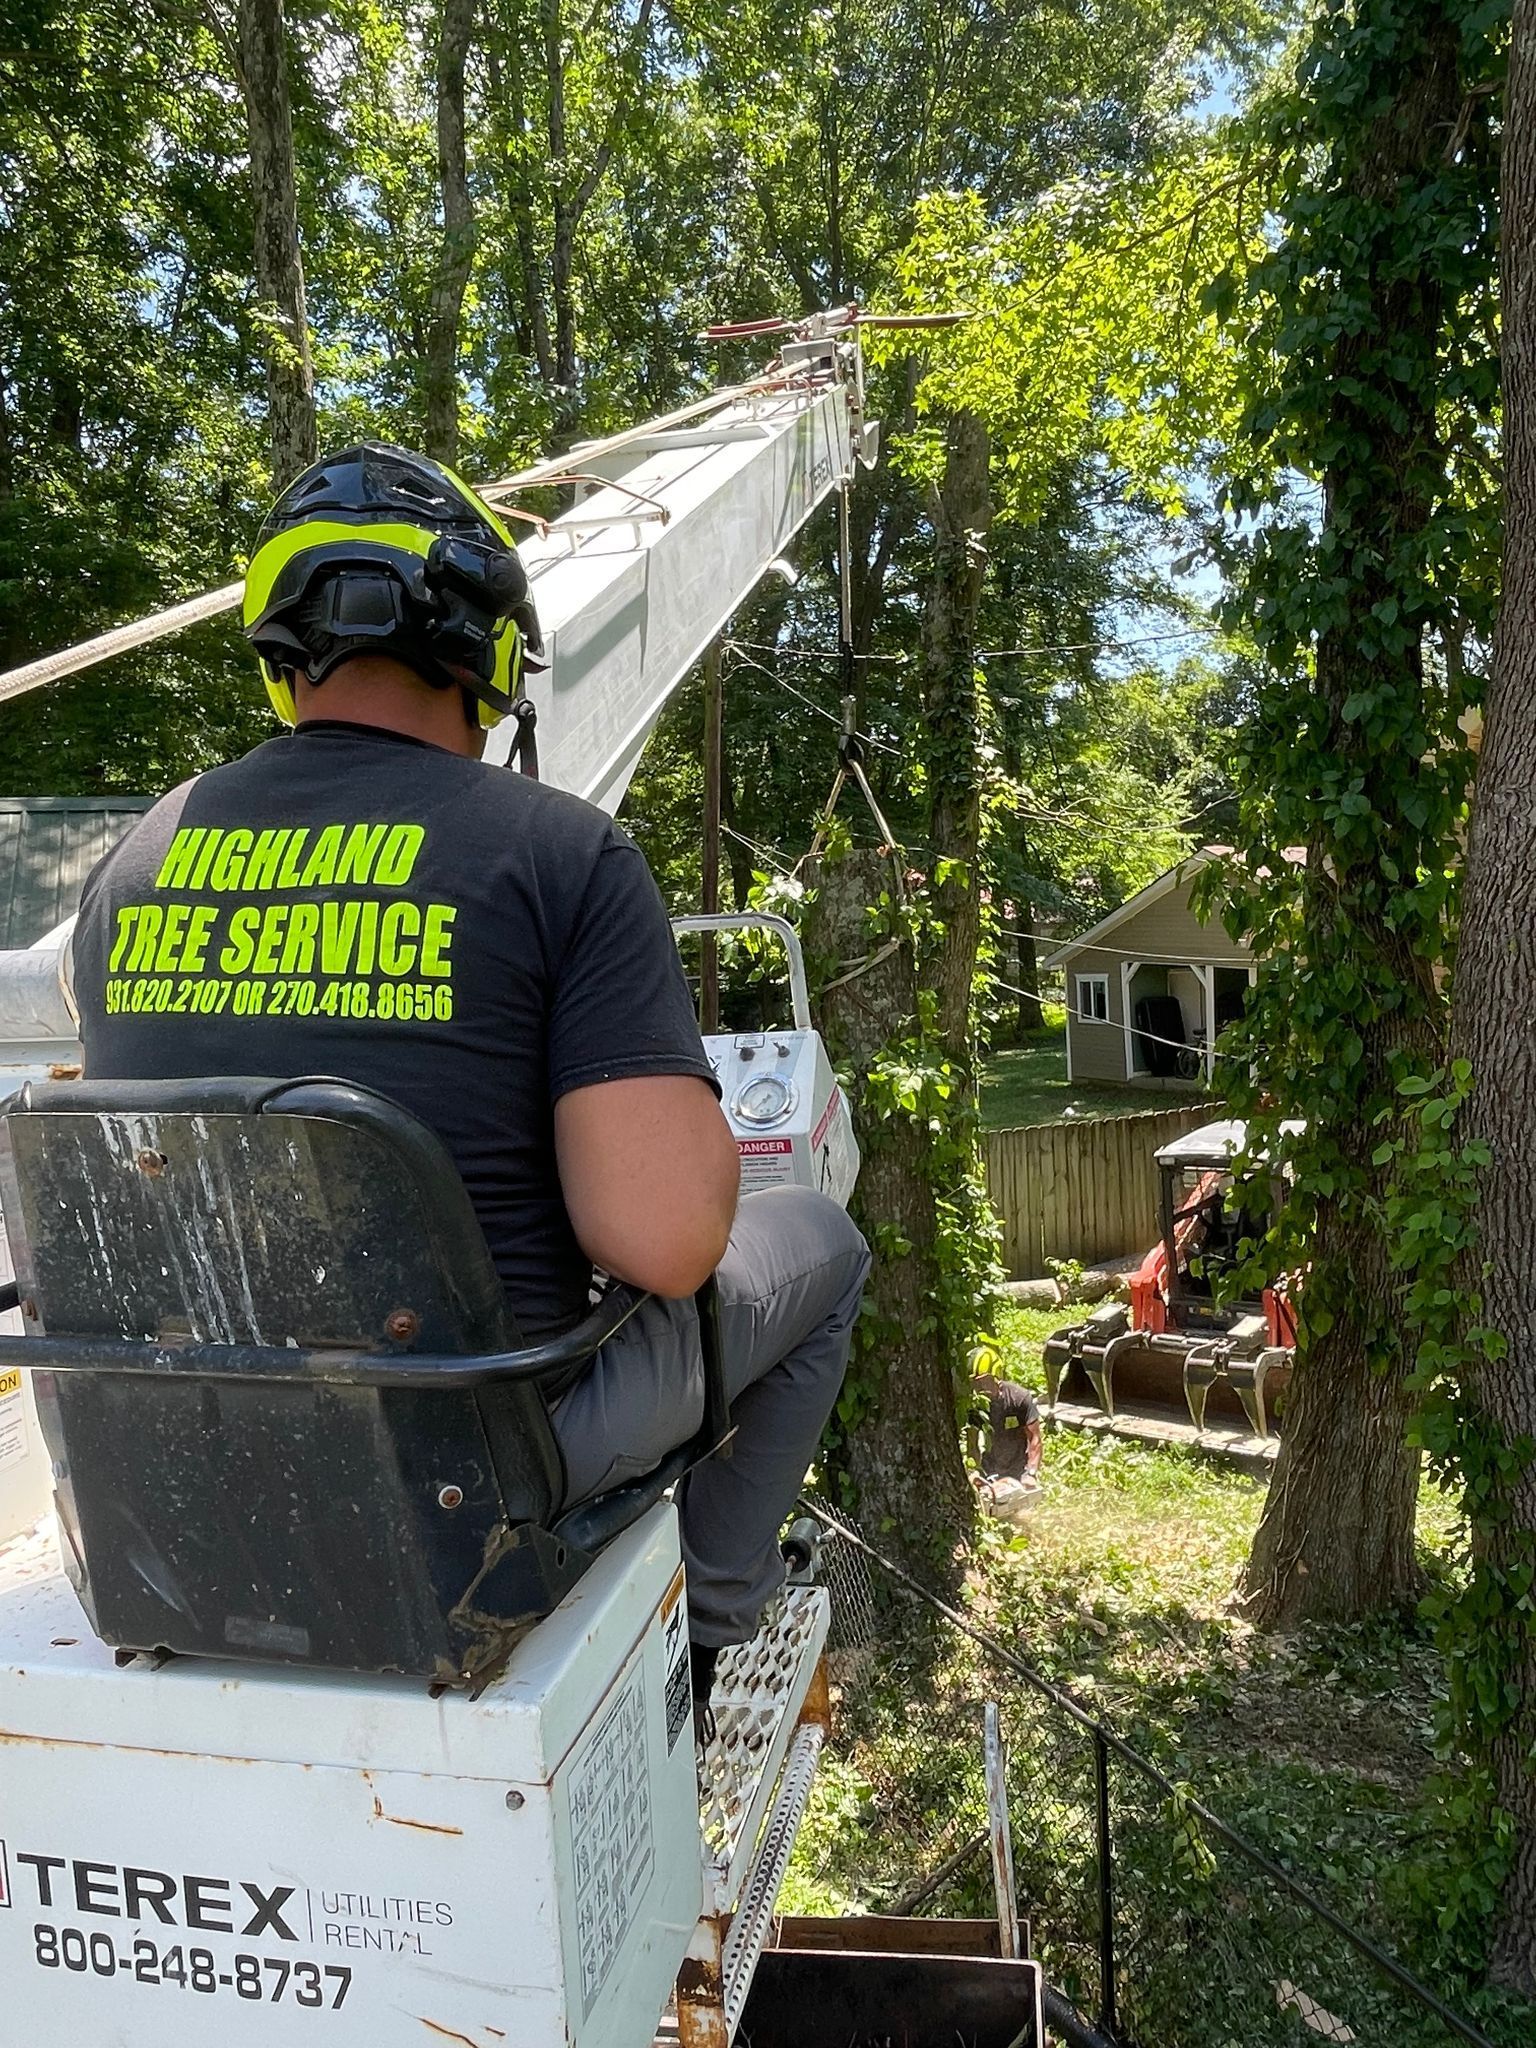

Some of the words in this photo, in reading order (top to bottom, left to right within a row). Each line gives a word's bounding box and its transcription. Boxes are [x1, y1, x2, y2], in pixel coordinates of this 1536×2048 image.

[154, 823, 426, 892] HIGHLAND
[108, 904, 220, 973] TREE
[219, 901, 458, 978] SERVICE
[105, 978, 233, 1016] 931.820.2107
[232, 981, 267, 1016] OR
[266, 981, 453, 1021] 270.418.8656
[16, 1851, 300, 1942] TEREX
[320, 1890, 454, 1927] UTILITIES
[33, 1923, 353, 2011] 800-248-8737
